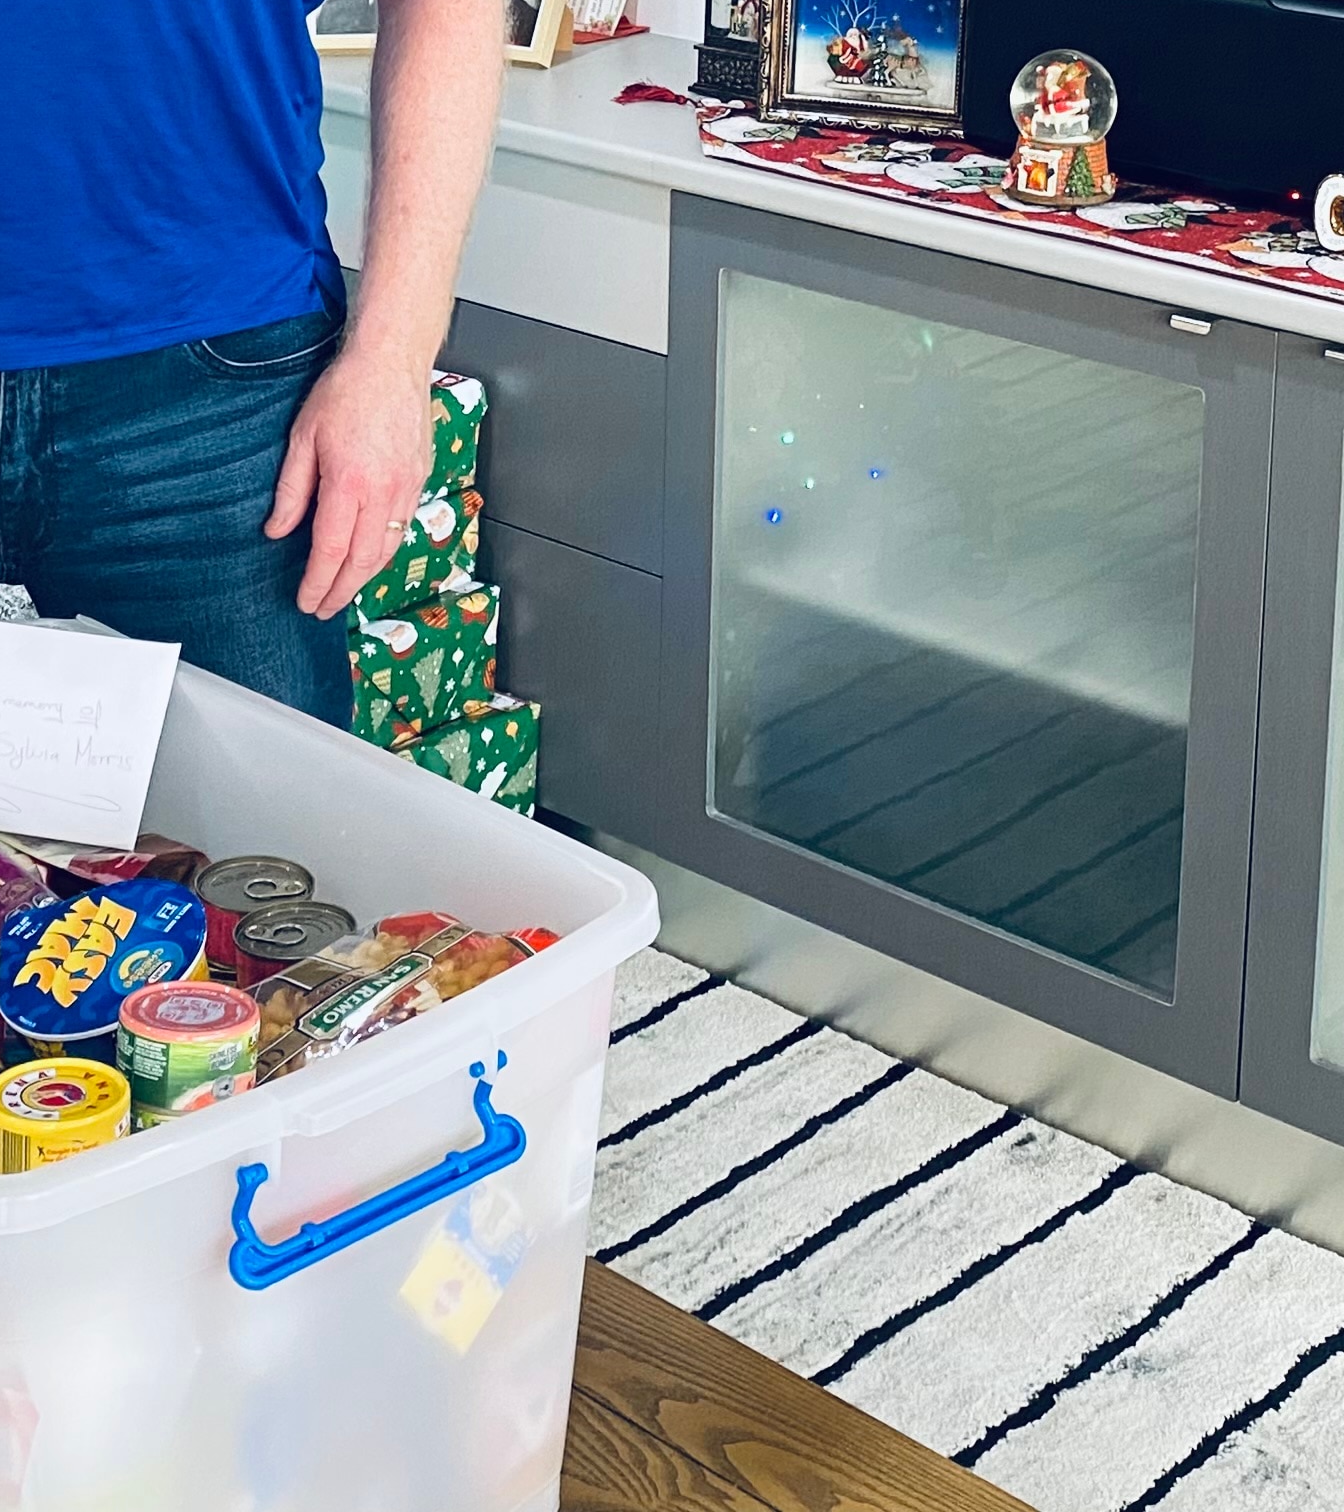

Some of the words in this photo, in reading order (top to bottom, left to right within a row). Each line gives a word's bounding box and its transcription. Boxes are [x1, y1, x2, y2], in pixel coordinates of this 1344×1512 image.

[2, 696, 64, 724] memory
[72, 699, 102, 730] of
[74, 735, 132, 771] Morris
[13, 895, 101, 994] MAC
[52, 895, 137, 1008] EASY
[372, 965, 412, 987] SAN
[323, 985, 377, 1024] REMO
